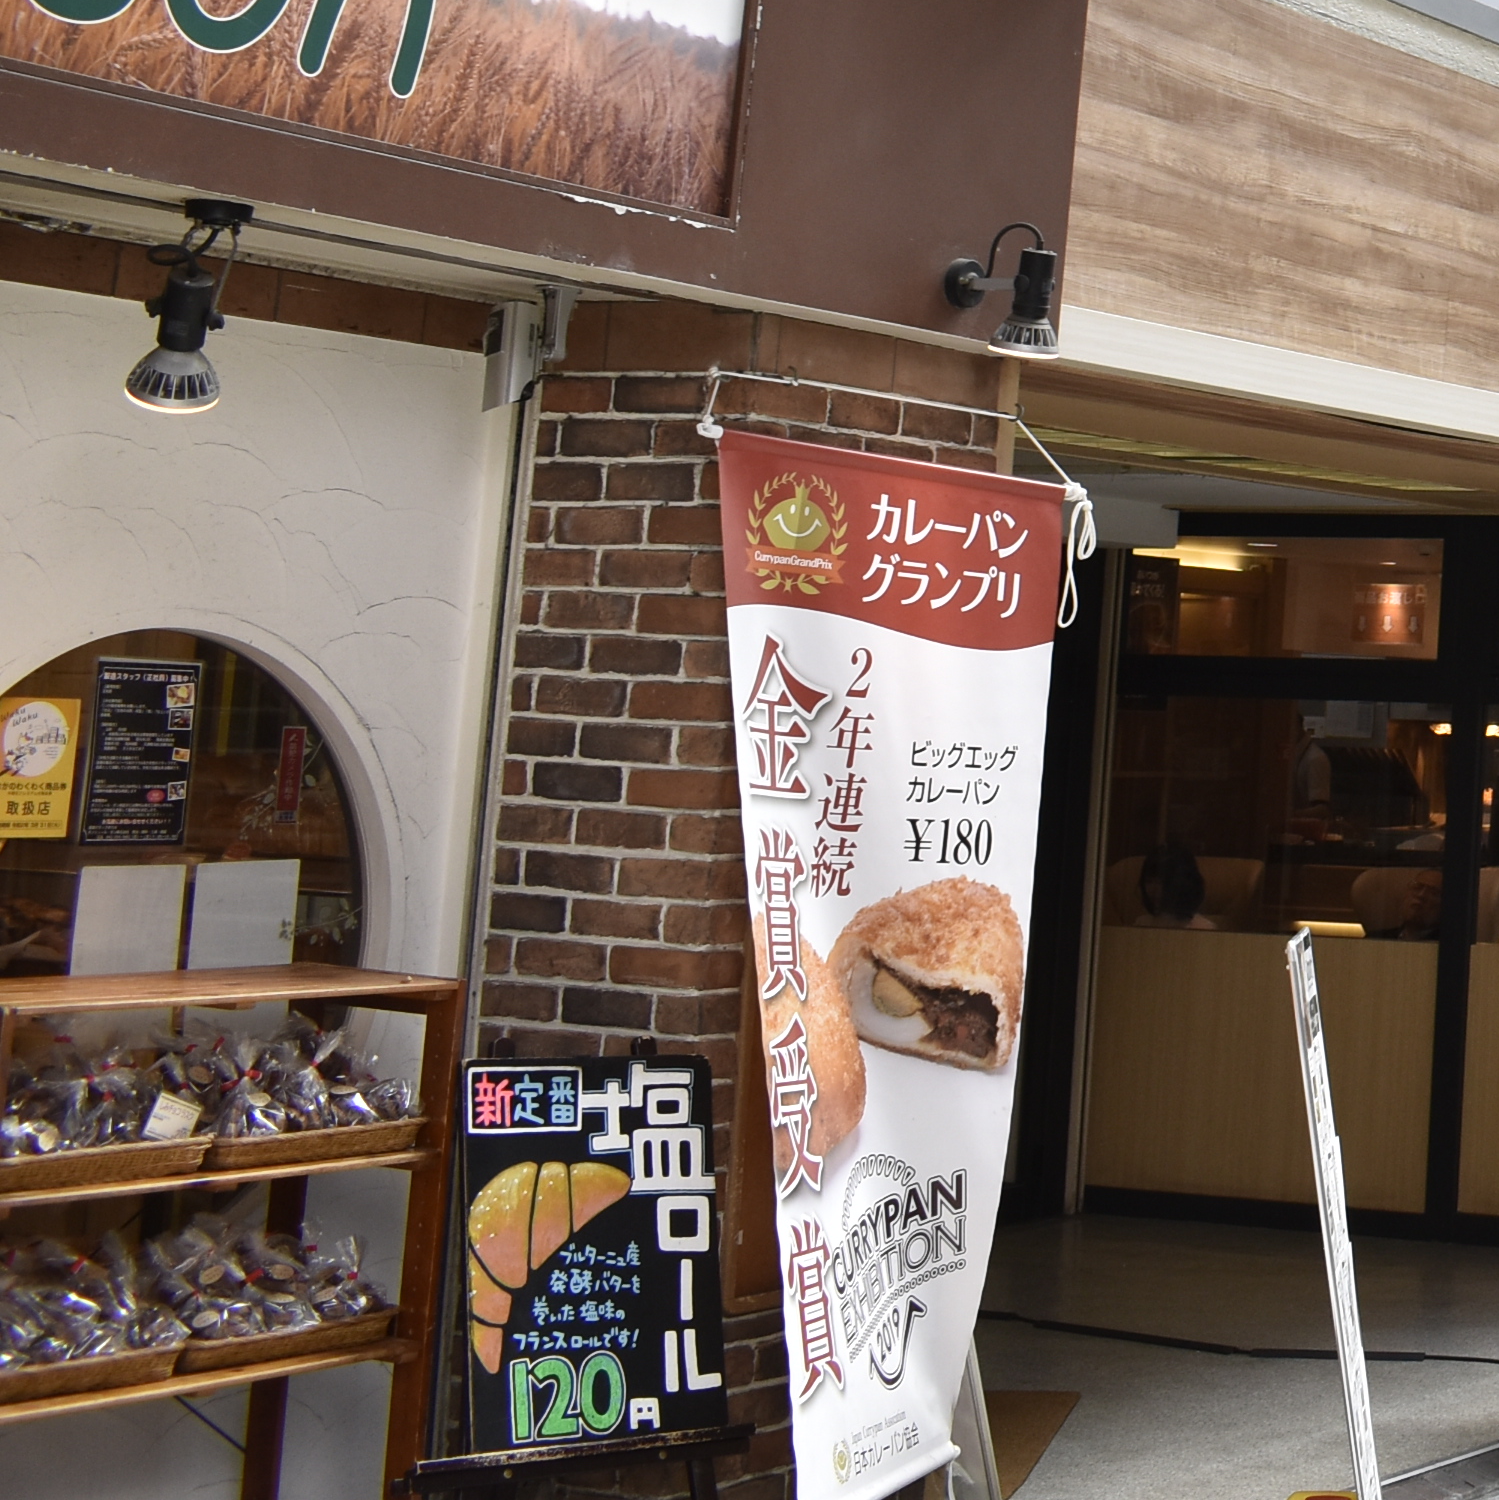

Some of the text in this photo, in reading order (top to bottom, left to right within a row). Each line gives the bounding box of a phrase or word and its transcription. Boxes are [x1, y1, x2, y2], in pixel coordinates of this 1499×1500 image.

[866, 493, 1029, 559] カレーパン
[862, 553, 1022, 619] グランプリ
[12, 712, 38, 727] Waku
[809, 646, 874, 898] 2年連続
[910, 739, 1019, 772] ビッグエッグ
[6, 801, 51, 816] 取扱店
[905, 776, 1001, 807] カレーパン
[904, 817, 993, 866] ¥180
[742, 632, 845, 1400] 金賞受賞
[474, 1073, 577, 1128] 新定番
[561, 1240, 641, 1268] ブルターニュ産
[580, 1061, 723, 1393] 塩ロール
[832, 1168, 967, 1296] CURRYPAN
[550, 1269, 641, 1296] 発酵バターを
[839, 1214, 968, 1348] EXHIBITION
[876, 1307, 901, 1365] 2019
[852, 1421, 919, 1476] 日本カレーパン協会
